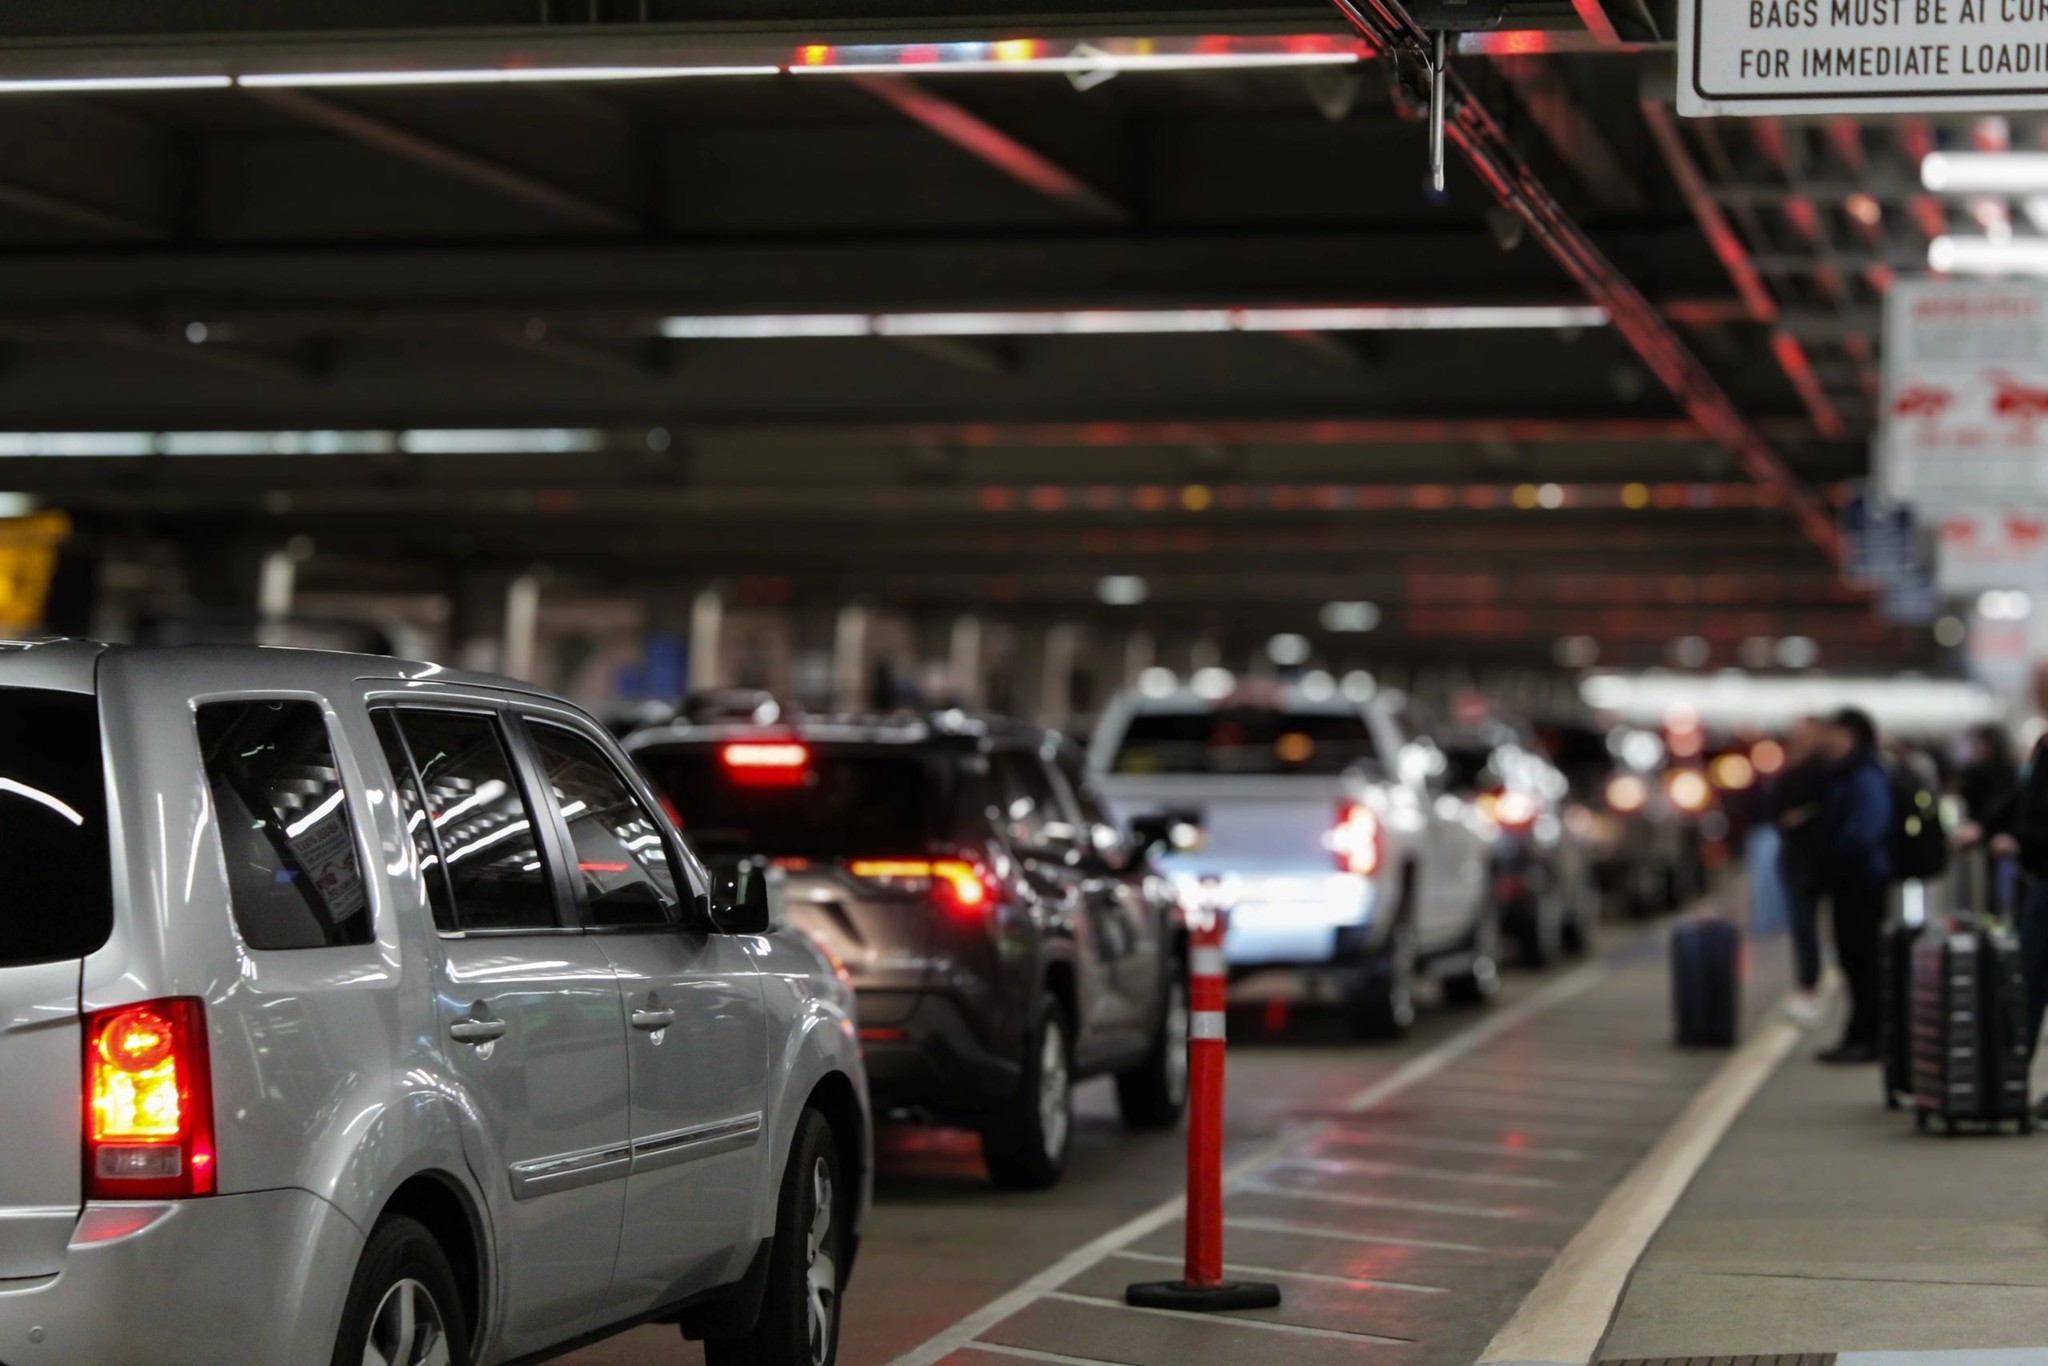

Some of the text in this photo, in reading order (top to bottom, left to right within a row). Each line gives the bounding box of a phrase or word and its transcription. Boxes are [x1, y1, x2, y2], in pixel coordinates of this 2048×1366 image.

[1750, 0, 1818, 28] BAGS
[1831, 0, 1899, 26] MUST
[1915, 0, 1947, 24] BE
[1740, 43, 2048, 78] FOR IMMEDIATE LOADI
